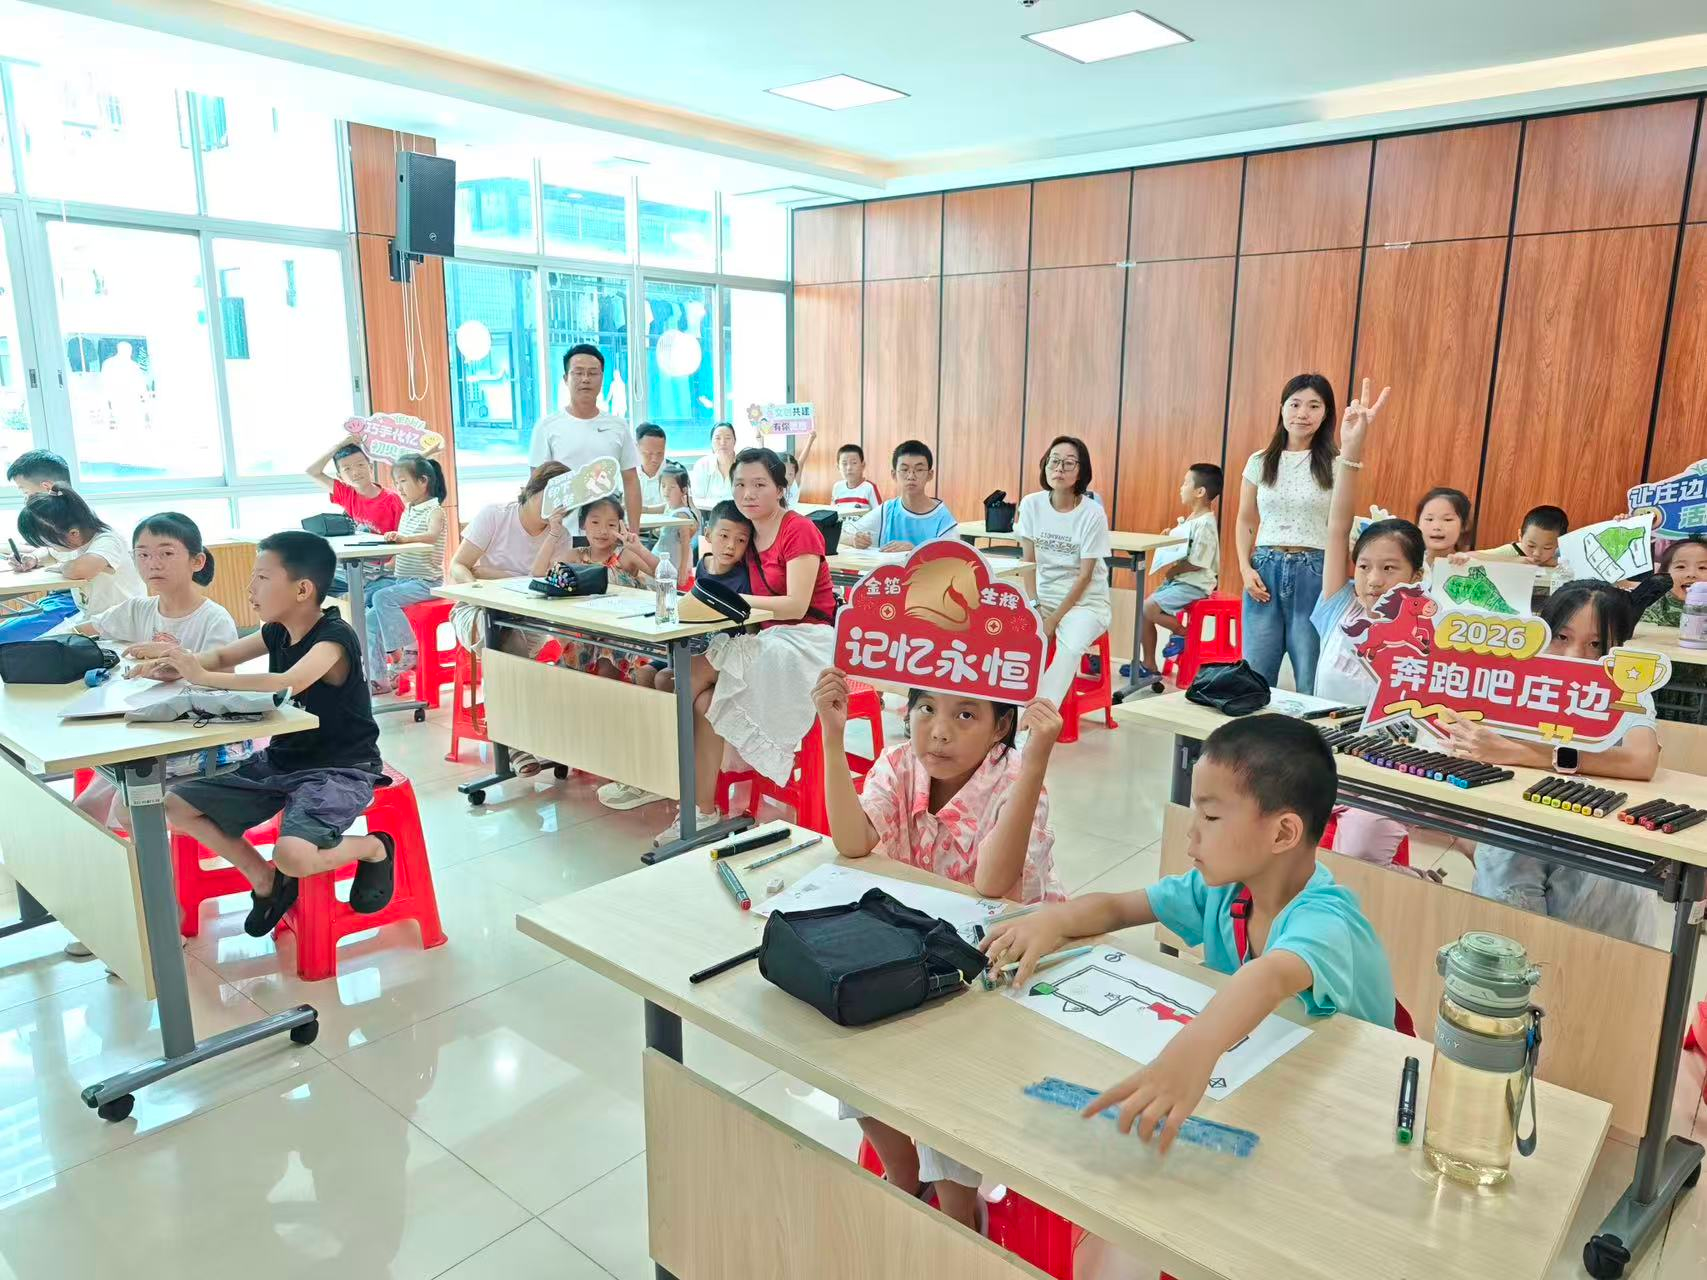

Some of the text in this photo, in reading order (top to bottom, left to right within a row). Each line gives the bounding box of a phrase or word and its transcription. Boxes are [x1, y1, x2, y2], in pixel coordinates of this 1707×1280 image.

[1630, 479, 1707, 508] 让庄边
[1678, 502, 1707, 530] 活
[864, 577, 1020, 610] 金箔 生辉
[1449, 619, 1527, 650] 2026
[845, 626, 1032, 690] 记忆永恒
[1390, 655, 1612, 721] 奔跑吧庄边
